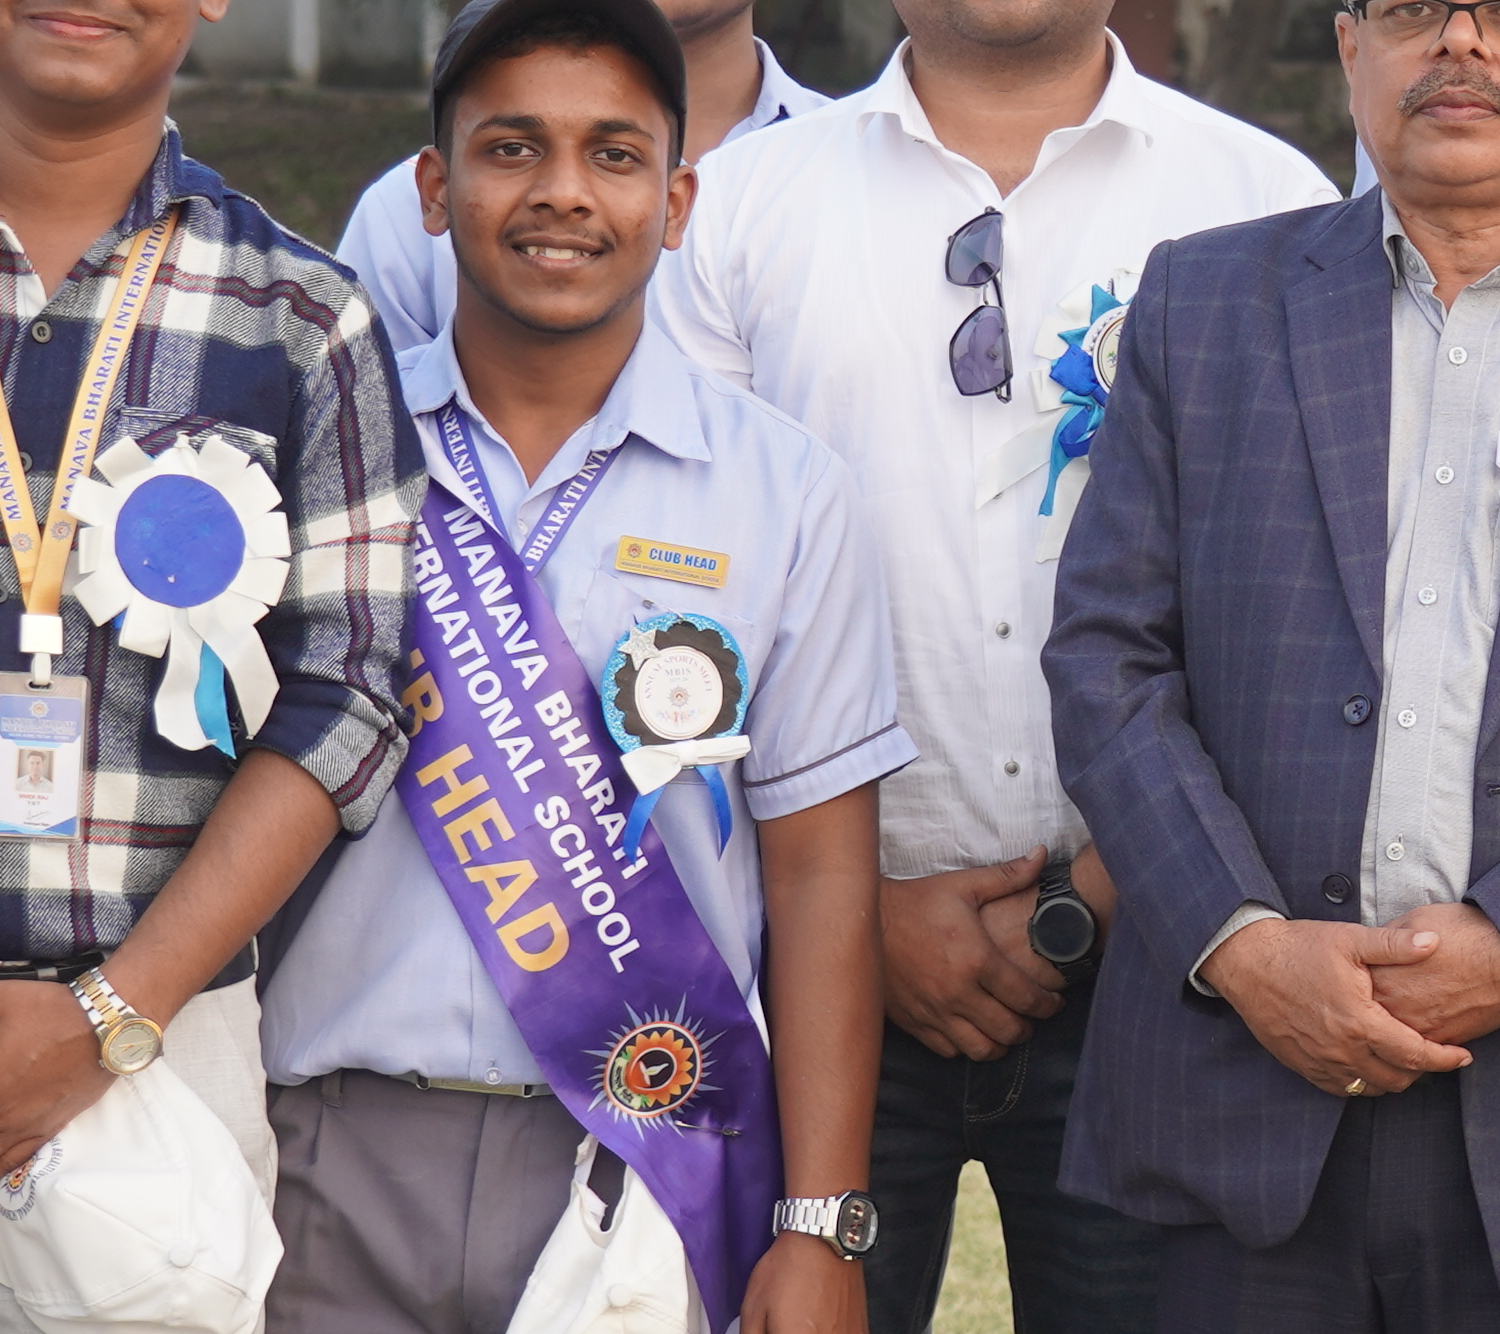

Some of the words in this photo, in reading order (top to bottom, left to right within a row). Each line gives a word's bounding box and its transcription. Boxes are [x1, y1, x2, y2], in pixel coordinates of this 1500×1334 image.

[60, 427, 95, 511] MANAVA
[83, 335, 123, 420] BHARATI
[442, 504, 550, 692] MANAVA
[528, 483, 588, 561] BHARATI
[648, 547, 682, 565] CLUB
[684, 554, 717, 571] HEAD
[412, 513, 547, 795] ERNATIONAL
[533, 795, 642, 974] SCHOOL
[415, 742, 571, 973] HEAD
